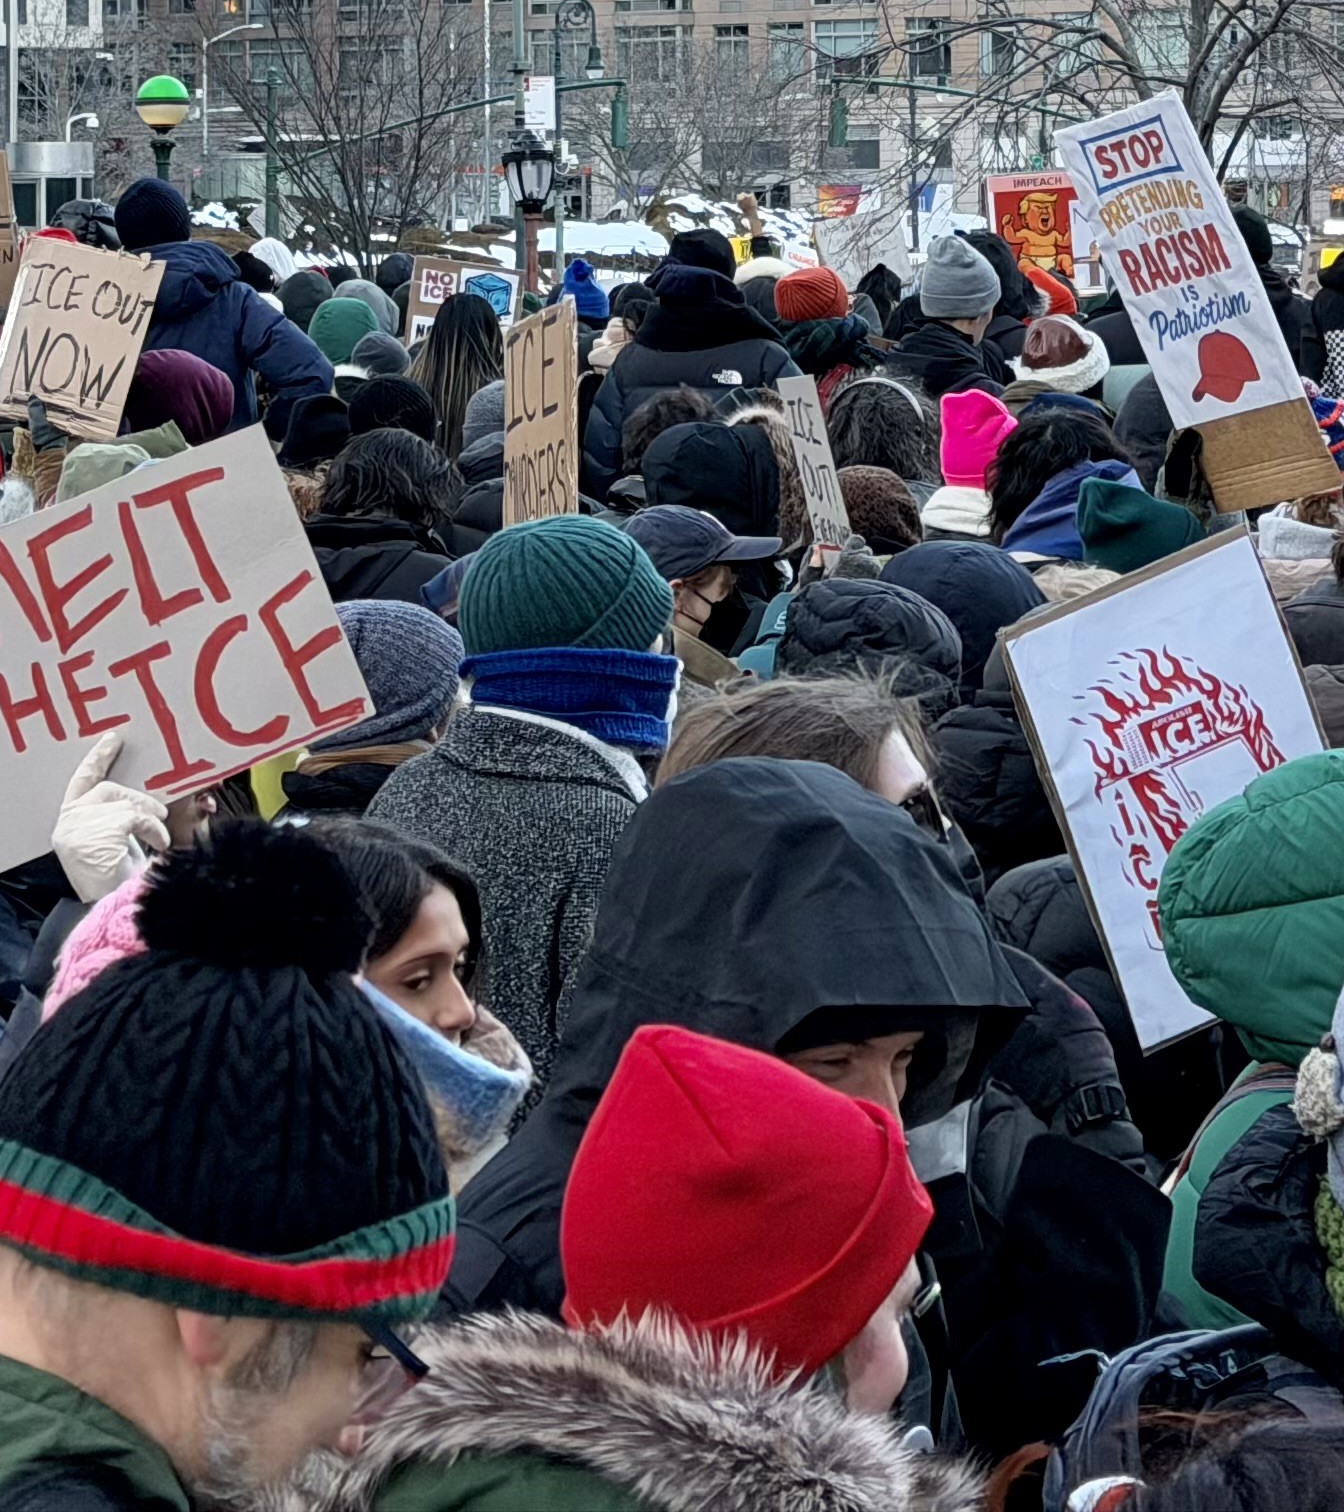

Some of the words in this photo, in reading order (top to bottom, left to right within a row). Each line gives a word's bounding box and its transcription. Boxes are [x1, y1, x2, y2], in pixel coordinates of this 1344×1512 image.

[1094, 129, 1164, 180] STOP
[1013, 177, 1063, 188] IMPEACH
[1099, 178, 1204, 238] PRETENDING
[1138, 211, 1183, 237] YOUR
[425, 270, 454, 286] NO
[1117, 223, 1232, 297] RACISM
[22, 263, 90, 311] ICE
[92, 280, 155, 336] OUT
[423, 285, 453, 300] ICE
[1181, 284, 1200, 303] IS
[1149, 290, 1252, 352] Patriotism
[8, 325, 127, 410] NOW
[506, 314, 560, 434] ICE
[787, 396, 822, 446] ICE
[108, 569, 367, 792] ICE
[1151, 706, 1194, 730] ABOLISH
[1151, 714, 1212, 760] ICE
